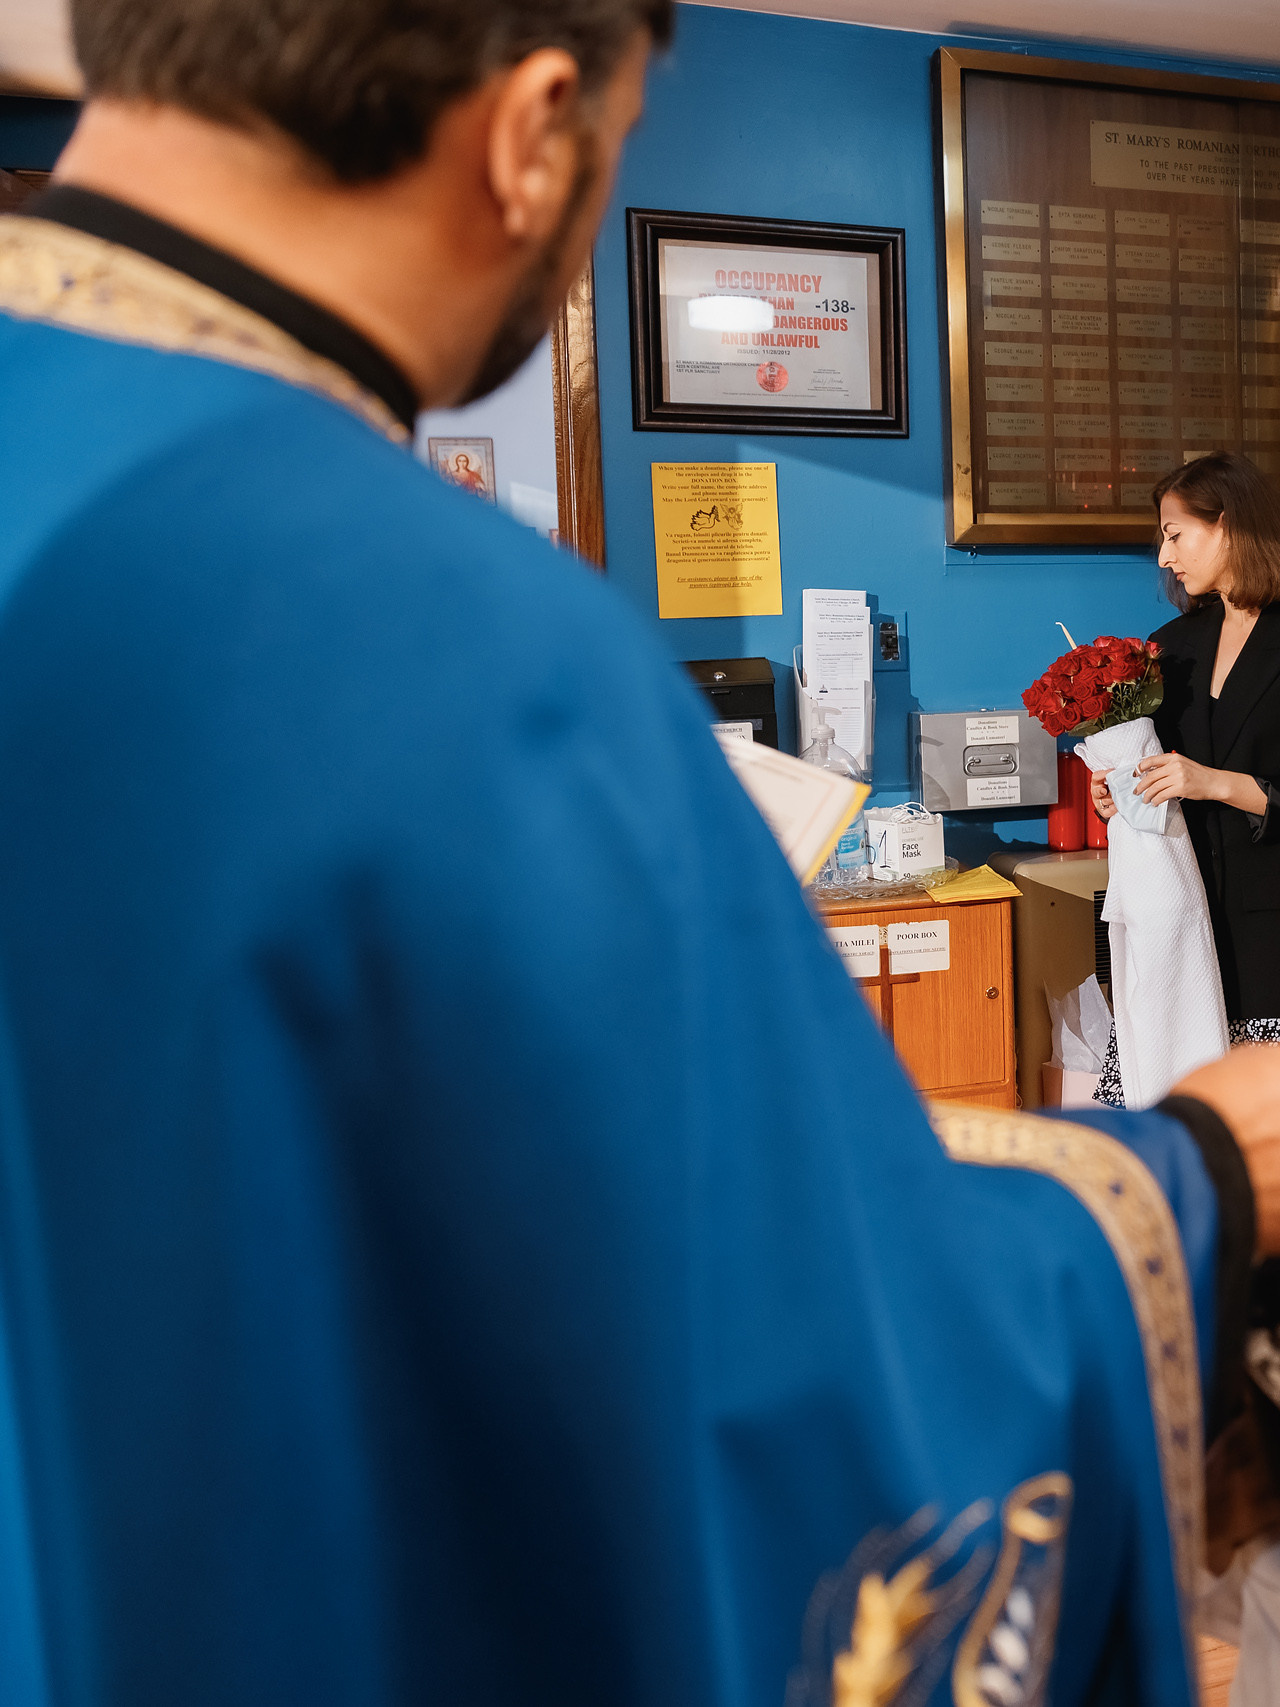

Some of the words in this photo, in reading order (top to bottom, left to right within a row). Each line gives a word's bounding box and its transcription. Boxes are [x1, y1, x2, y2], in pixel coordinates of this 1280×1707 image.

[1105, 132, 1121, 144] ST.
[1126, 134, 1170, 148] MARY'S
[1177, 138, 1240, 154] ROMANIAN
[1140, 159, 1150, 168] TO
[1154, 161, 1169, 170] THE
[1174, 163, 1193, 171] PAST
[1146, 172, 1166, 181] OVER
[1171, 173, 1186, 182] THE
[1191, 176, 1215, 185] YEARS
[1220, 178, 1239, 187] HAVE
[715, 269, 822, 294] OCCUPANCY
[815, 299, 856, 314] -138-
[773, 315, 848, 332] DANGEROUS
[721, 332, 748, 345] AND
[751, 333, 820, 349] UNLAWFUL
[902, 843, 919, 851] Face
[902, 850, 922, 859] Mask
[850, 939, 875, 947] MILEI
[897, 933, 919, 941] POOR
